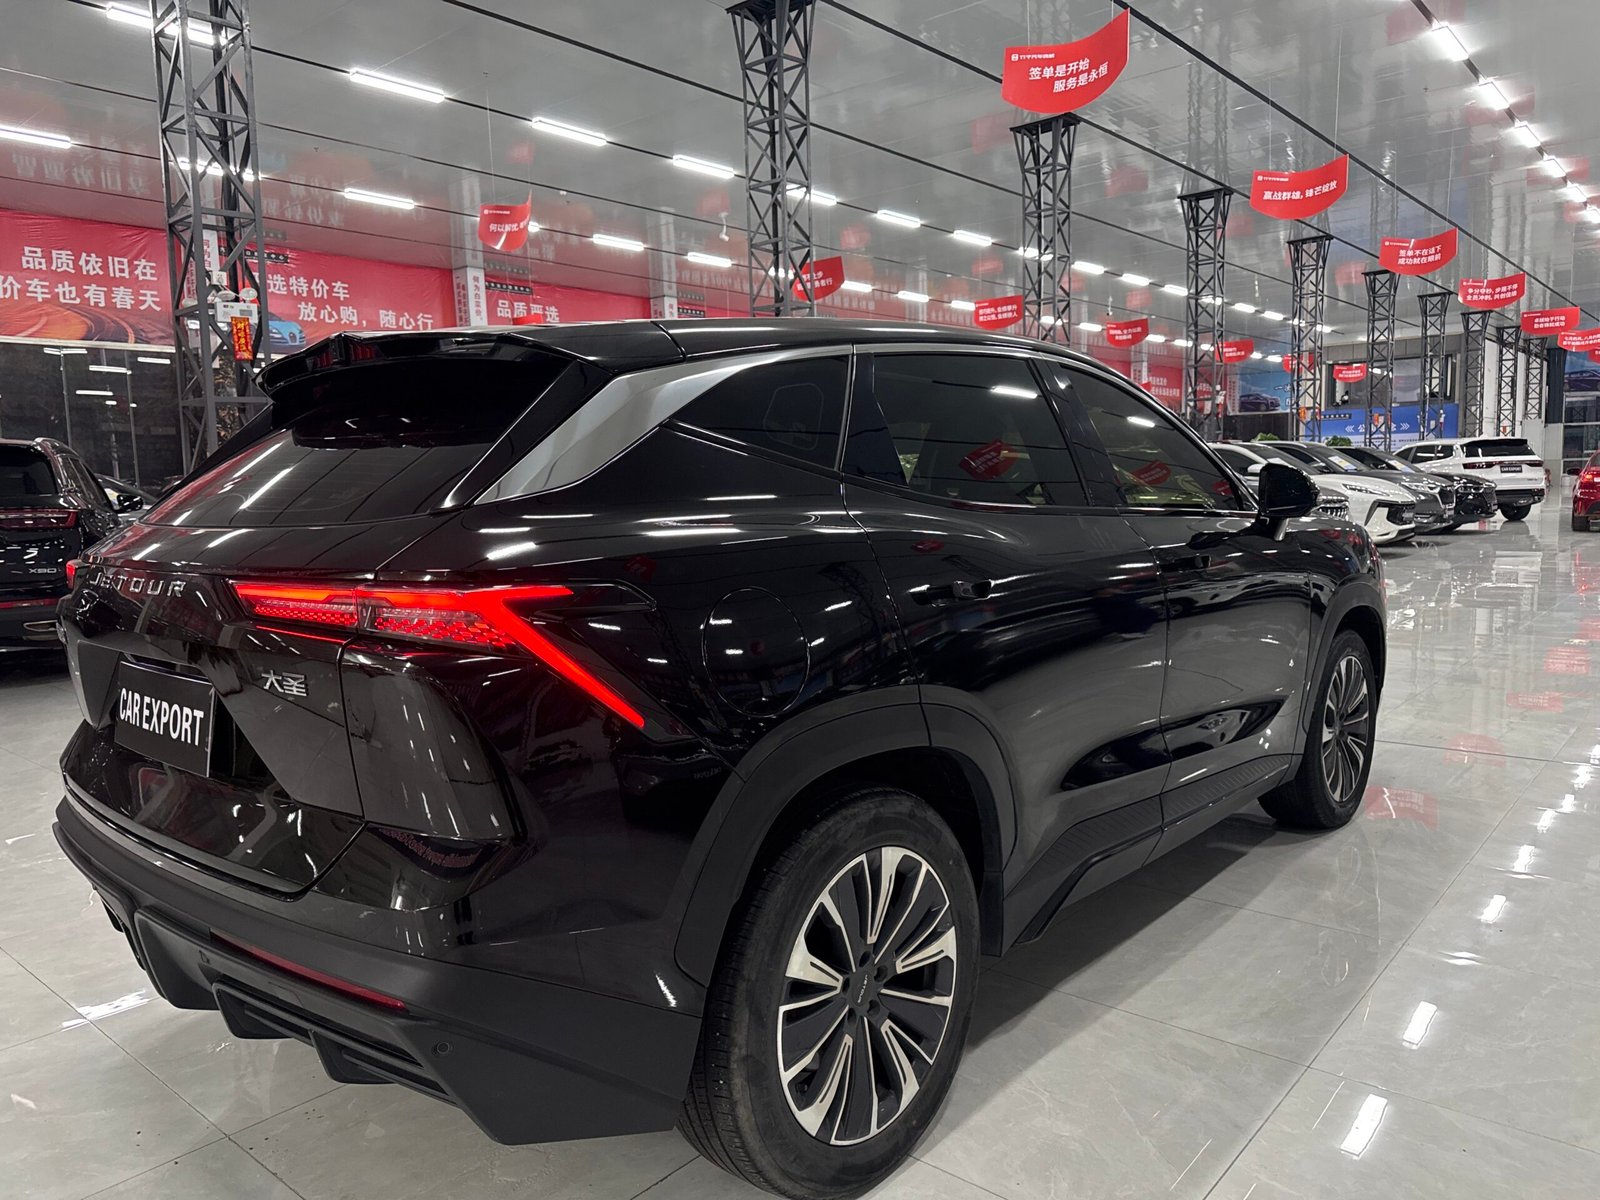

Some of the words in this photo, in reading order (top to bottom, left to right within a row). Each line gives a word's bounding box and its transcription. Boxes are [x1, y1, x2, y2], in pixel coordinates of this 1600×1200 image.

[1028, 57, 1090, 80] 签单是开始
[1052, 61, 1109, 93] 服务是永恒
[21, 246, 158, 281] 品质依旧在
[89, 571, 187, 598] JETOUR
[261, 669, 309, 697] 大圣
[119, 687, 140, 728] CAR
[142, 695, 205, 746] EXPORT
